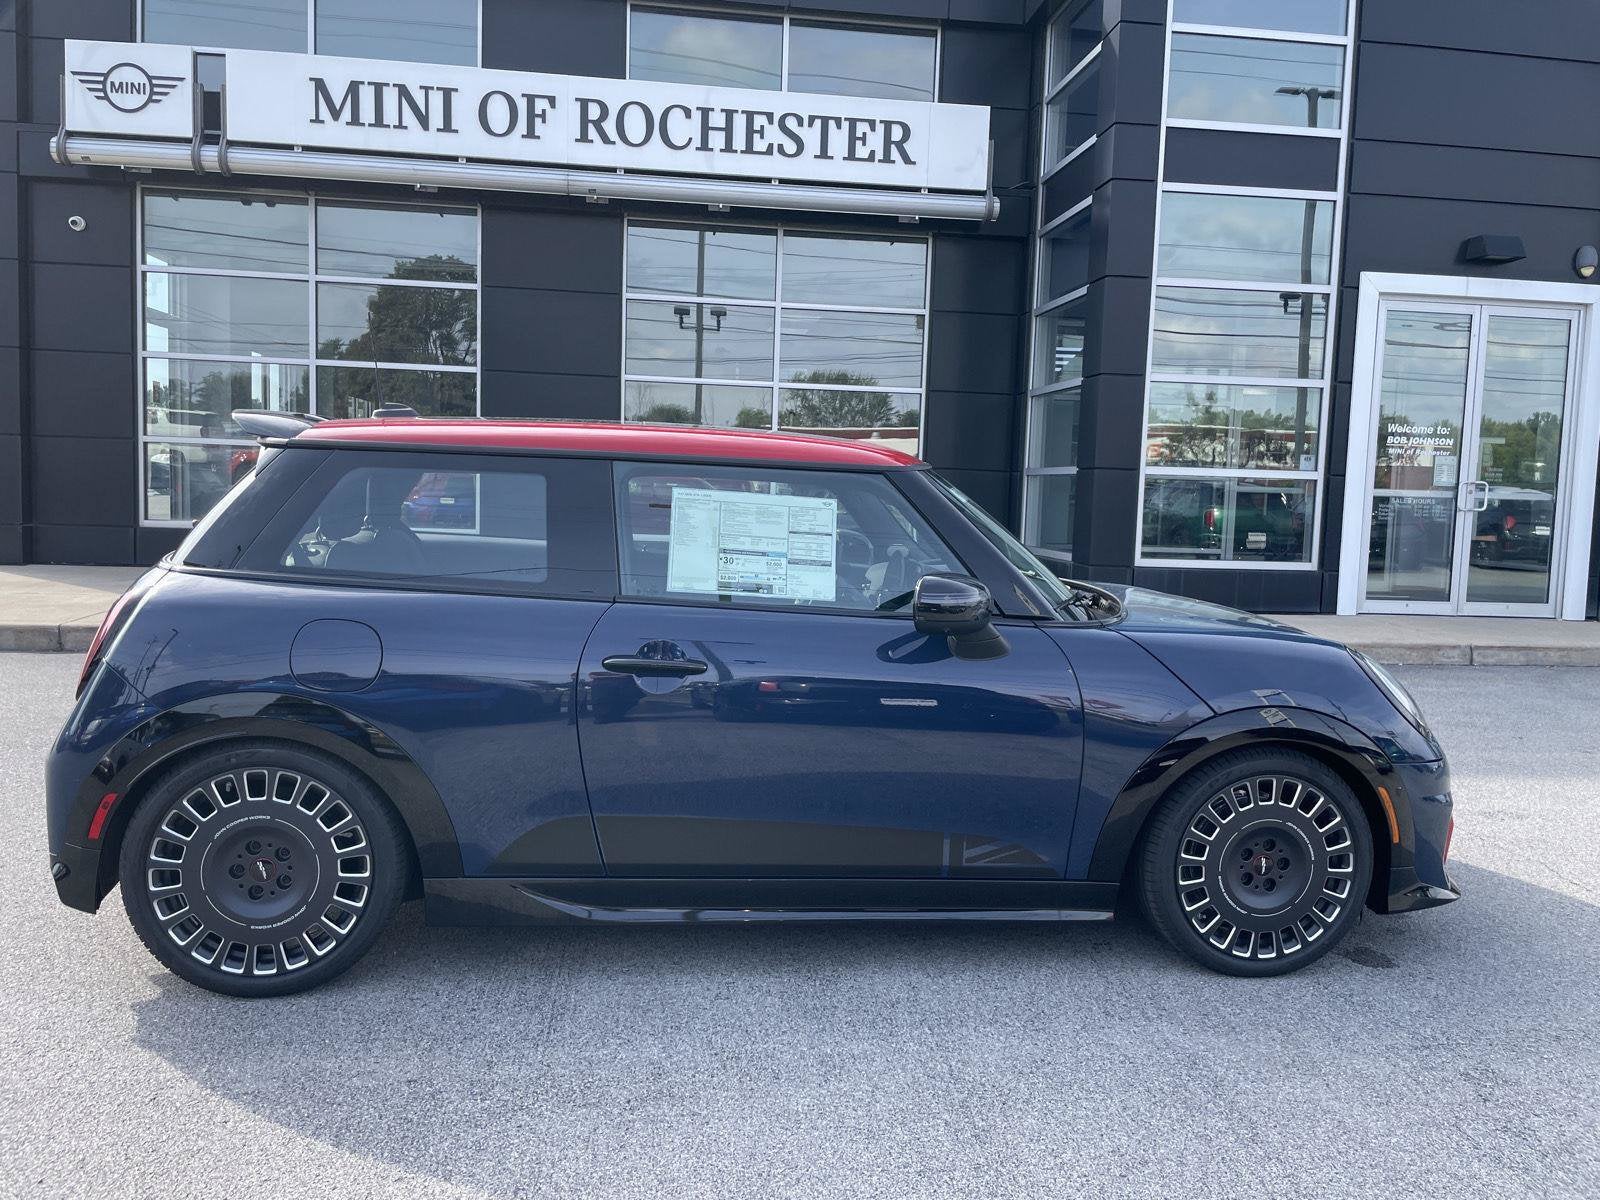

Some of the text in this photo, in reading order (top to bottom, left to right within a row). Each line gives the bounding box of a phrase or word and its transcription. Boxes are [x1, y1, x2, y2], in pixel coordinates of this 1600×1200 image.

[109, 81, 147, 96] MINI
[309, 77, 917, 166] MINI OF ROCHESTER
[1387, 423, 1451, 435] Welcome to:
[1386, 436, 1454, 446] BOB JOHNSON
